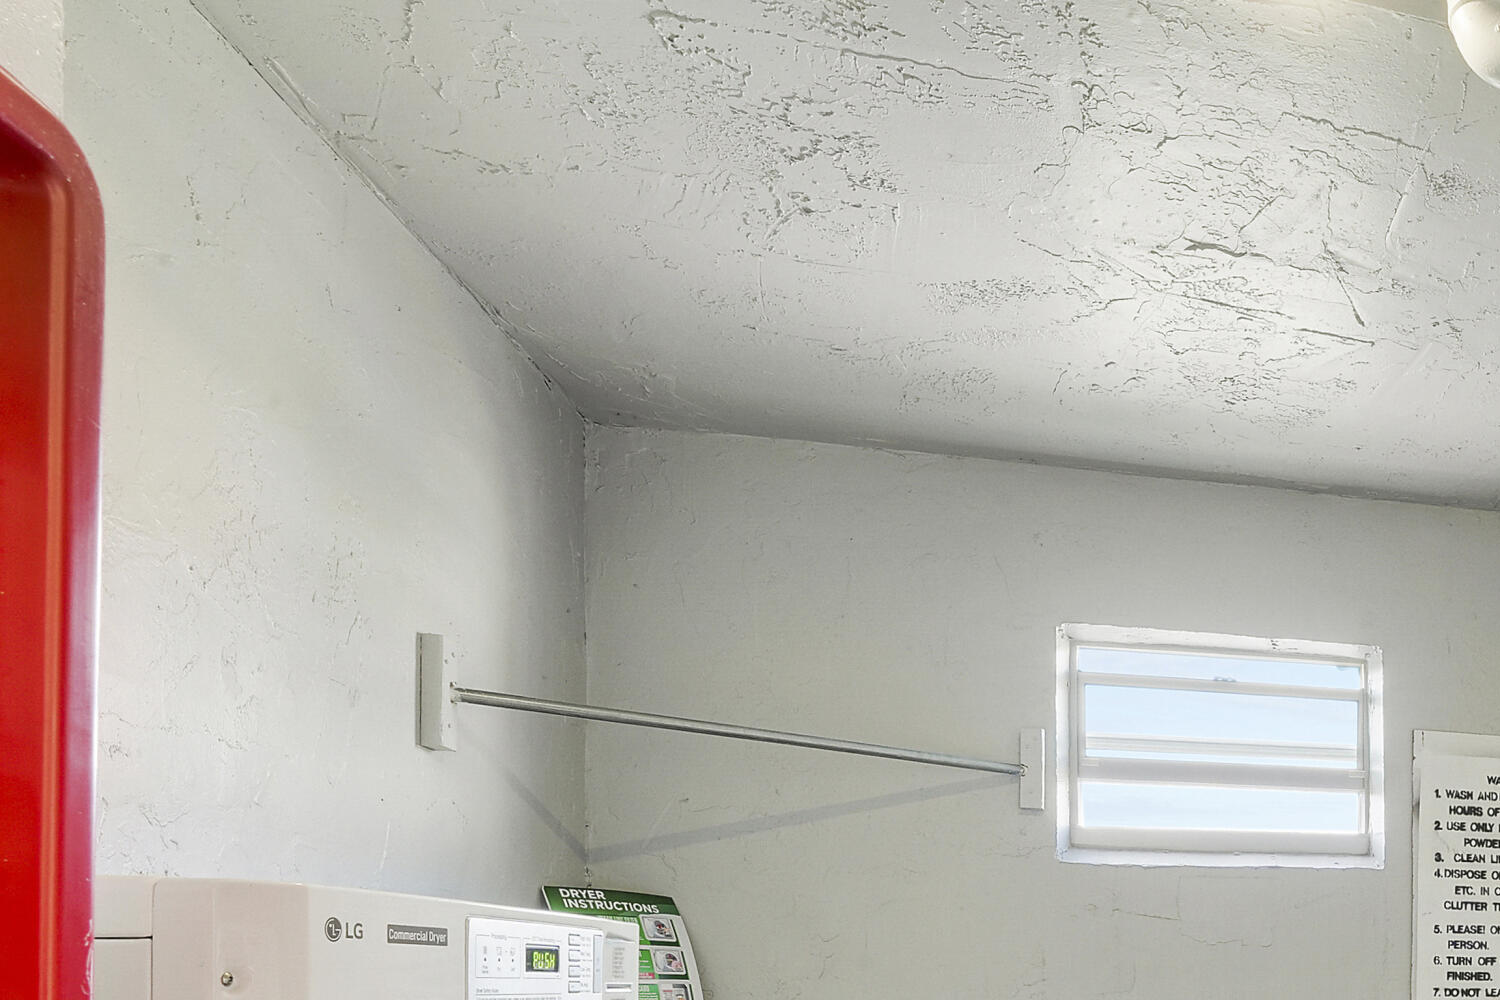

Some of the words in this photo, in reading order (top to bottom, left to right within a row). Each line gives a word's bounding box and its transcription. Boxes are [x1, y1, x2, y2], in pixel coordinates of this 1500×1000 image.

[1434, 790, 1441, 798] 1.
[1446, 790, 1473, 800] WASH
[1478, 792, 1498, 802] AND
[1449, 806, 1483, 816] HOURS
[1487, 808, 1500, 816] OF
[1434, 821, 1442, 830] 2.
[1447, 822, 1466, 831] USE
[1471, 823, 1494, 832] ONLY
[1435, 853, 1444, 862] 3.
[1454, 854, 1485, 863] CLEAN
[1444, 869, 1486, 879] DISPOSE
[559, 888, 606, 900] DRYER
[1455, 886, 1475, 895] ETC.
[1480, 887, 1490, 896] IN
[563, 899, 659, 913] INSTRUCTIONS
[1444, 901, 1488, 912] CLUTTER
[346, 922, 363, 939] LG
[389, 929, 427, 942] Commercial
[429, 931, 446, 944] Dryer
[1434, 925, 1442, 934] 5.
[1448, 940, 1489, 950] PERSON.
[533, 952, 555, 970] PUSH
[1434, 957, 1442, 965] 6.
[1447, 957, 1472, 966] TURN
[1478, 957, 1497, 966] OFF
[1447, 972, 1492, 981] FINISHED.
[1433, 988, 1440, 997] 7.
[1444, 988, 1459, 997] DO
[1461, 988, 1481, 997] NOT
